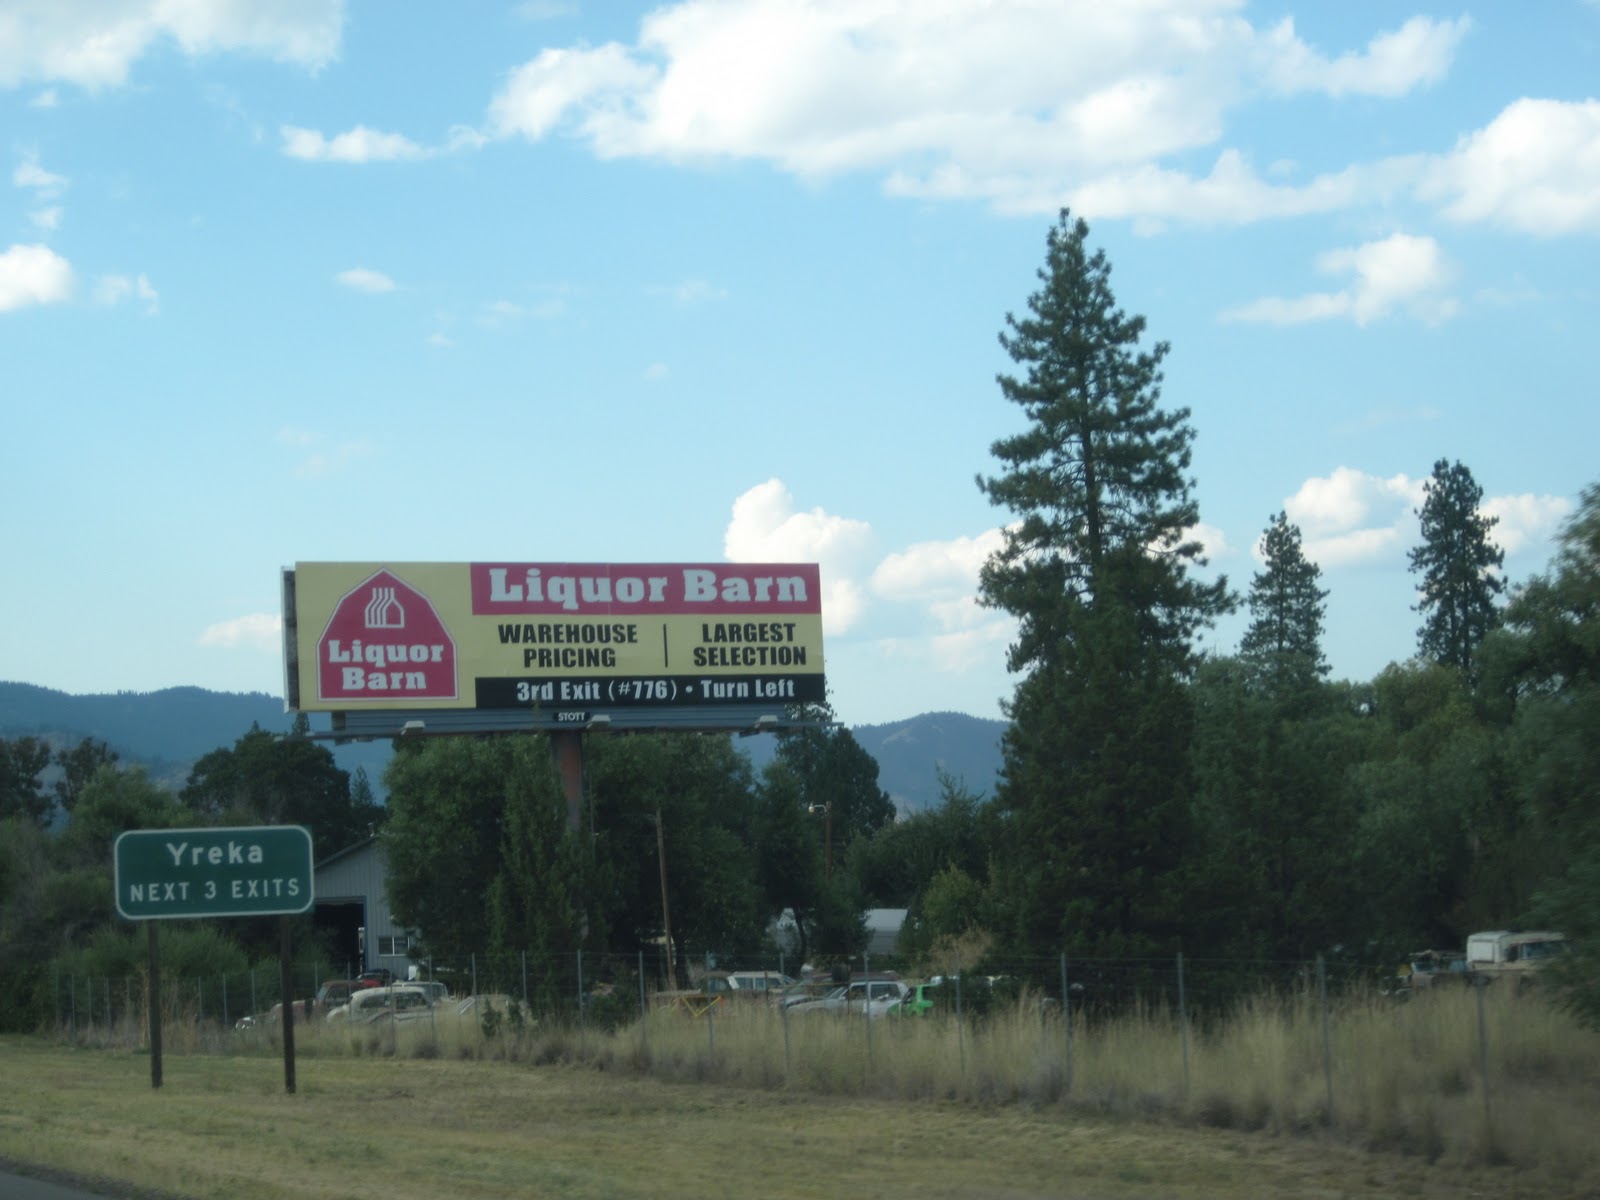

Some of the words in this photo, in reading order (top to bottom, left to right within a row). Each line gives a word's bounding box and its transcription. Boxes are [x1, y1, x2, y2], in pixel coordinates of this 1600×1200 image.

[489, 568, 668, 610] Liquor
[682, 569, 808, 602] Barn
[498, 624, 638, 644] WAREHOUSE
[702, 623, 796, 643] LARGEST
[328, 639, 444, 668] Liquor
[523, 648, 616, 668] PRICING
[693, 646, 806, 667] SELECTION
[342, 667, 426, 690] Barn
[516, 681, 554, 701] 3rd
[560, 681, 601, 700] Exit
[607, 679, 678, 702] (#776)
[700, 680, 749, 698] Turn
[755, 678, 795, 698] Left
[557, 712, 586, 722] STOTT
[166, 841, 264, 867] Yreka
[130, 882, 190, 902] NEXT
[204, 880, 217, 900] 3
[231, 878, 300, 899] EXITS
